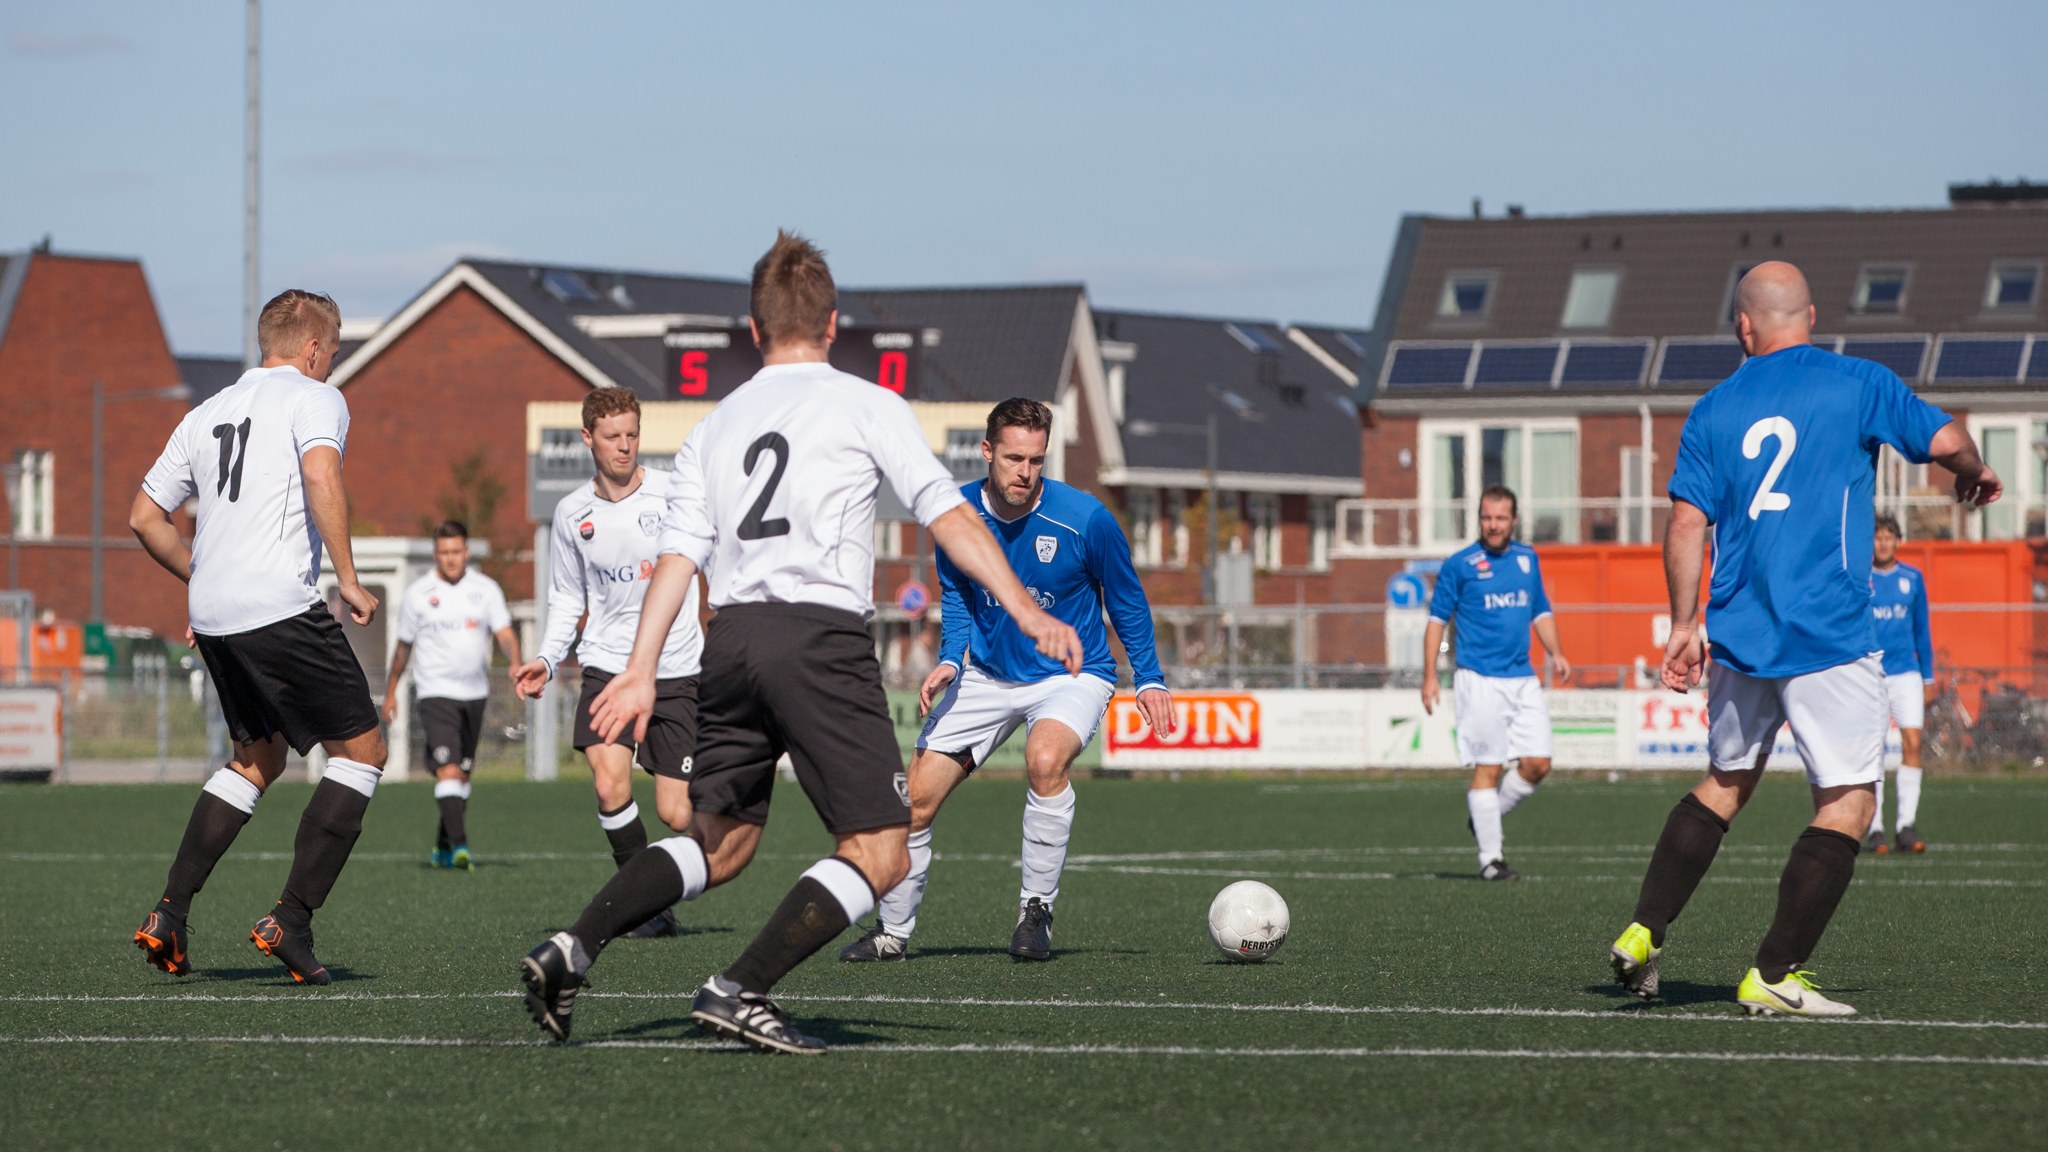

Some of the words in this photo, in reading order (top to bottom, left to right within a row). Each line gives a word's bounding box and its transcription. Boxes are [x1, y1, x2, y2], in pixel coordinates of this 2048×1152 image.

[679, 351, 709, 396] 5
[878, 351, 908, 395] 0
[212, 416, 252, 503] 11
[1742, 415, 1797, 521] 2
[736, 431, 791, 541] 2
[596, 565, 634, 585] ING
[1484, 593, 1515, 610] ING
[1872, 606, 1893, 620] NG
[681, 755, 693, 773] 8
